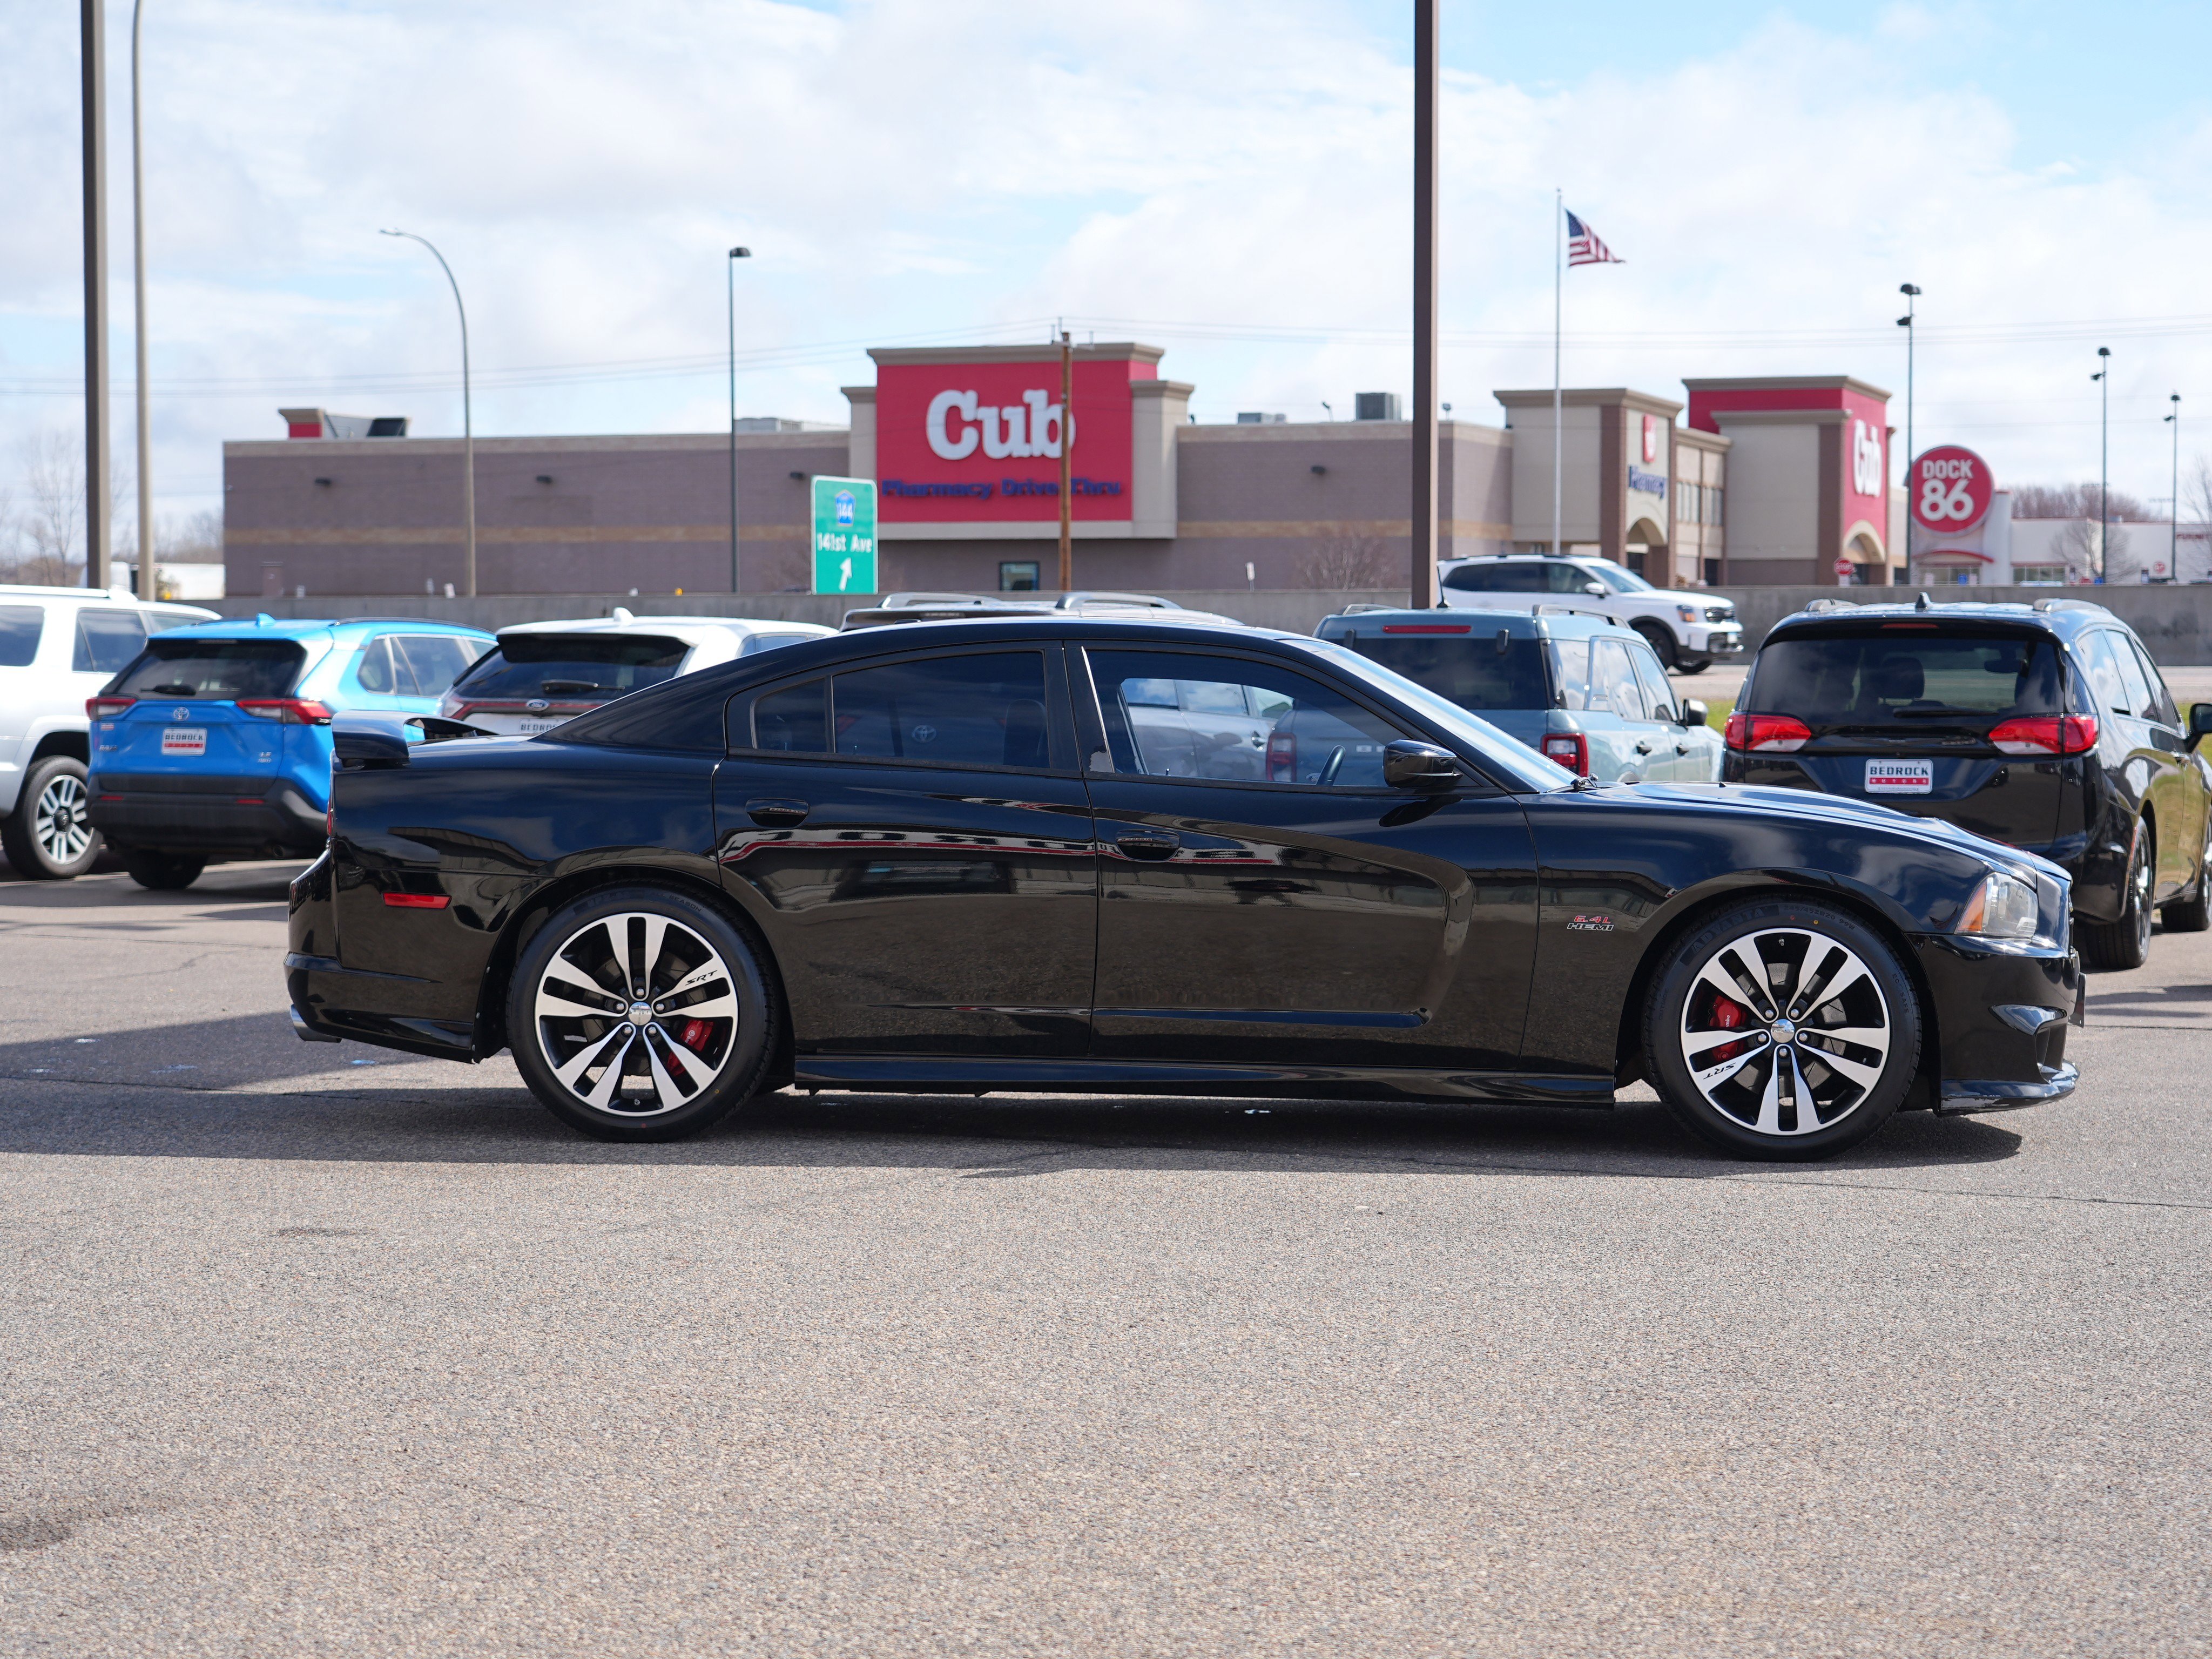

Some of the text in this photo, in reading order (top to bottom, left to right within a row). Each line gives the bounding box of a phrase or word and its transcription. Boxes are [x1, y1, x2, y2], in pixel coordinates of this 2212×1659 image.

[926, 389, 1076, 460] Cub
[1853, 419, 1882, 497] Cub
[1923, 459, 1973, 480] DOCK
[881, 477, 1121, 500] Pharmacy Drive Thru
[1920, 478, 1974, 521] 86
[817, 532, 873, 553] 141st Ave
[1870, 766, 1928, 775] BEDROCK
[1567, 922, 1614, 931] HEMI
[1574, 915, 1611, 924] 6.4L
[1838, 919, 1856, 930] 99W
[1691, 908, 1765, 954] ADVANTA
[685, 970, 718, 986] SRT
[1900, 992, 1909, 1014] SAFE
[1703, 1062, 1736, 1080] SRT
